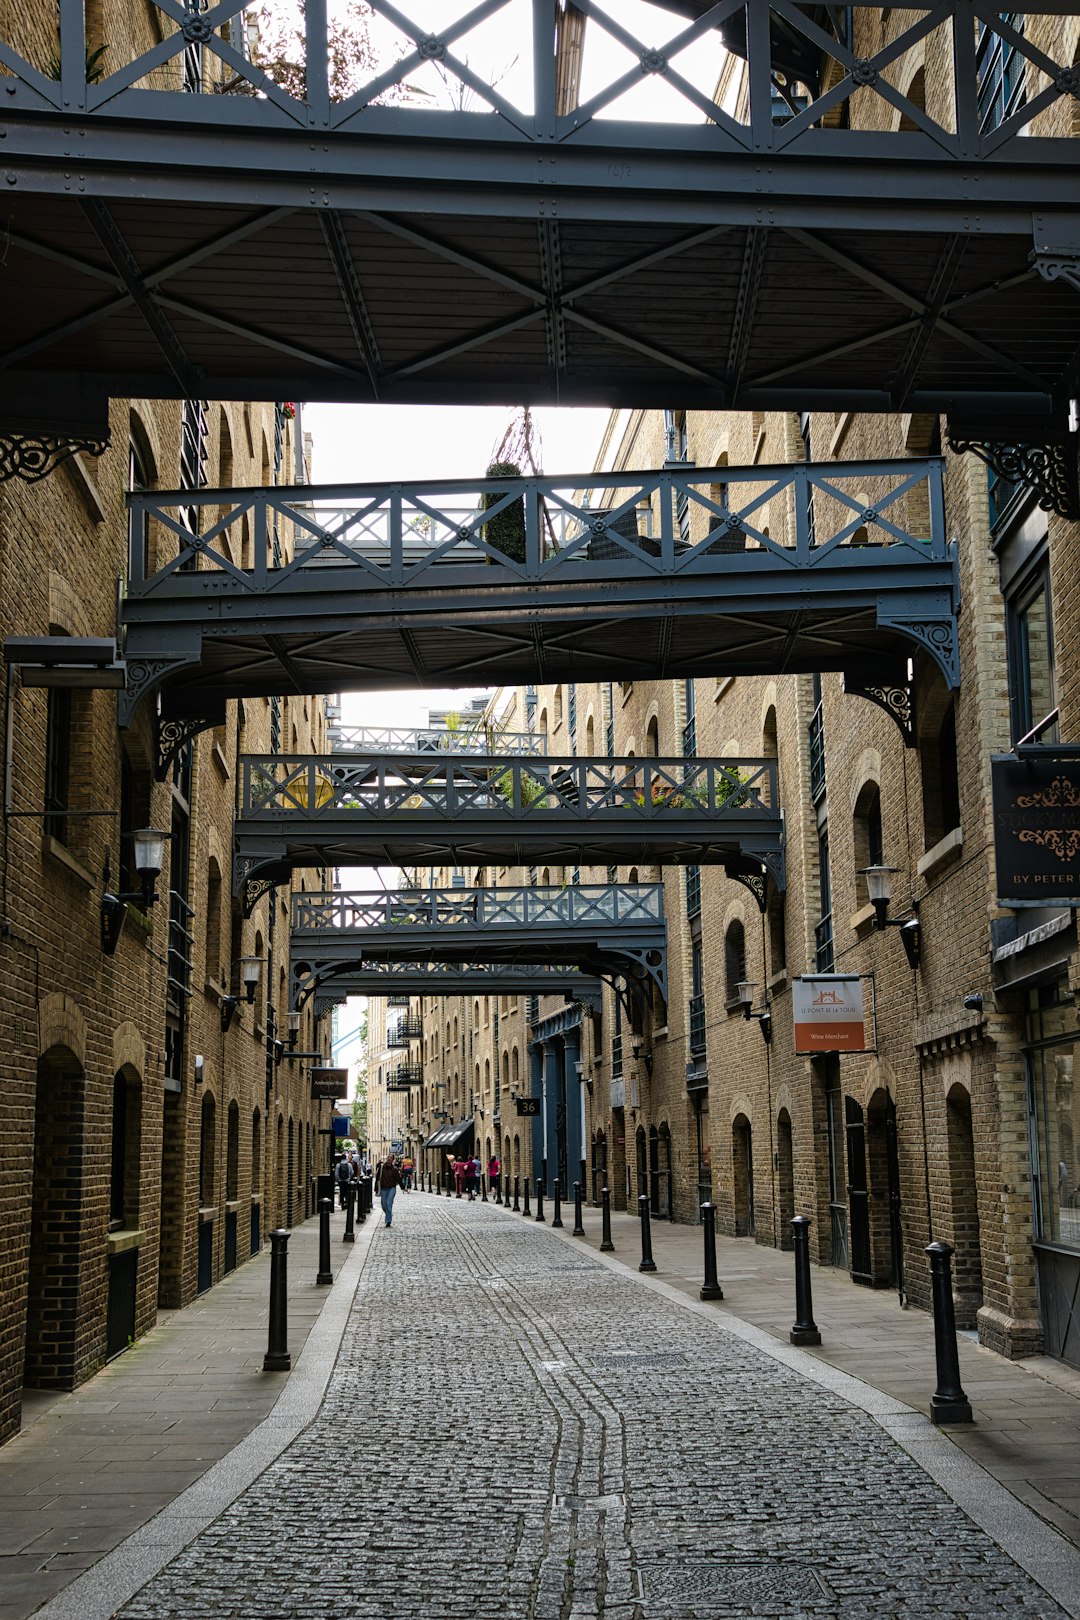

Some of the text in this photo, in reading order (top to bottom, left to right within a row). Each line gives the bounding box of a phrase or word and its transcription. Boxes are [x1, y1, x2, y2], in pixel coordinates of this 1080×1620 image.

[998, 812, 1057, 826] STICKY
[1013, 875, 1030, 884] BY
[1034, 874, 1074, 883] PETER
[522, 1102, 535, 1113] 36
